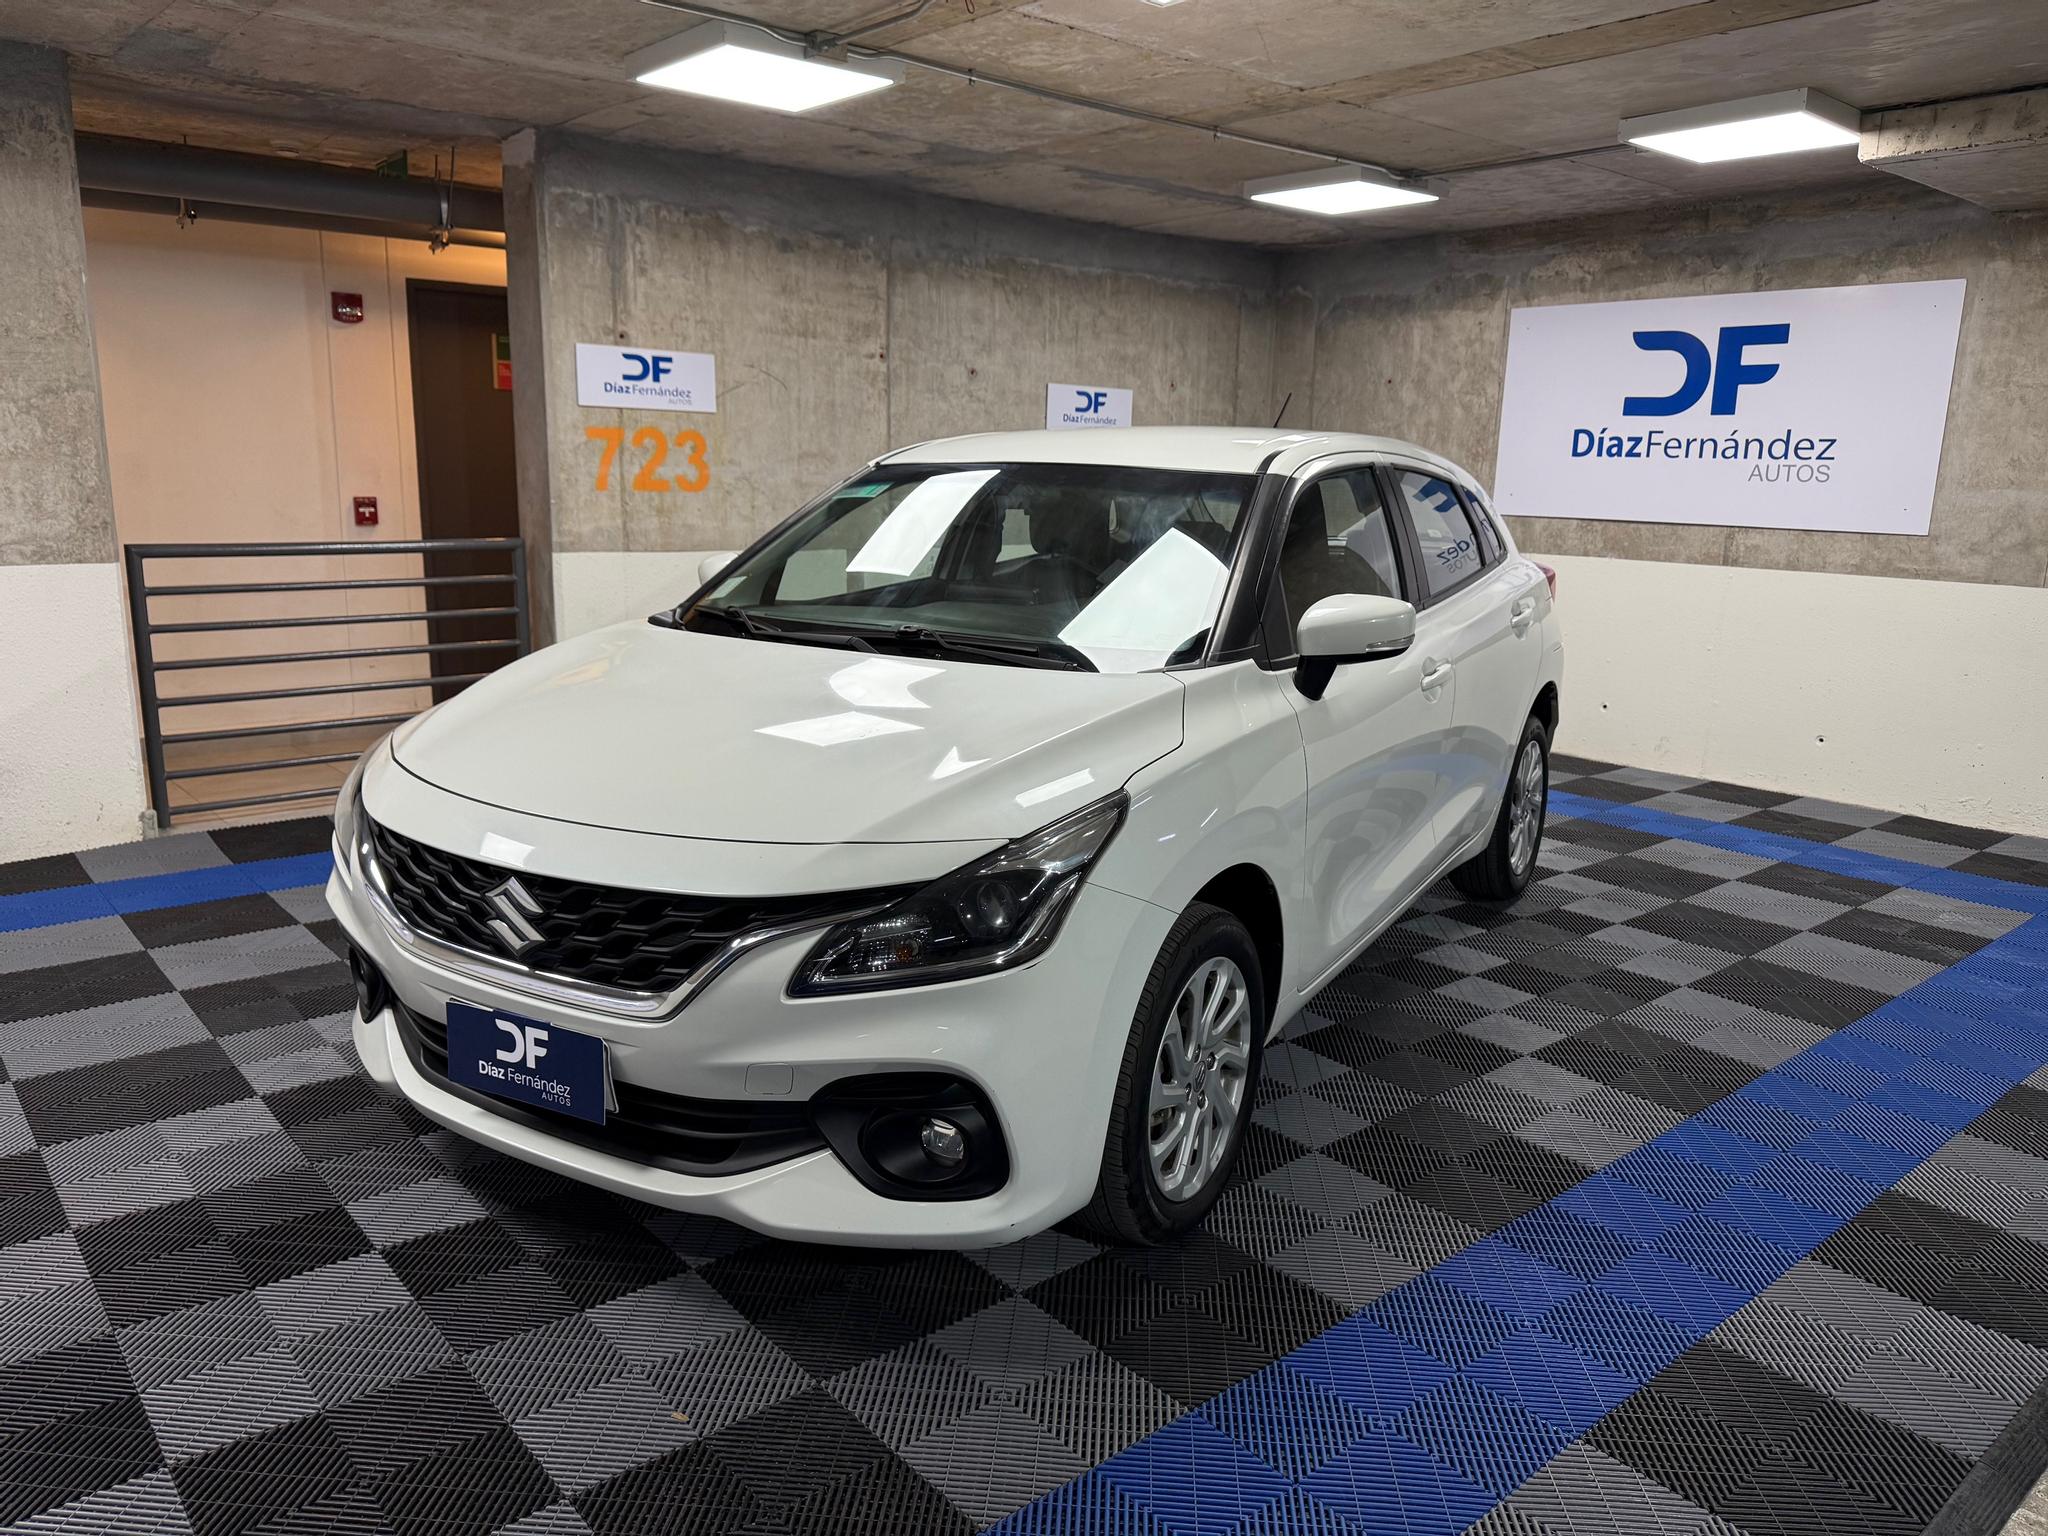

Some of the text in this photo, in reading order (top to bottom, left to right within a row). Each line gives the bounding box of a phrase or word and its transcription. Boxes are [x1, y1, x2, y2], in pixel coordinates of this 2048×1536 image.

[585, 425, 711, 493] 723
[1748, 464, 1831, 483] AUTOS
[478, 1060, 571, 1098] Díaz Fernández
[541, 1092, 571, 1107] AUTOS
